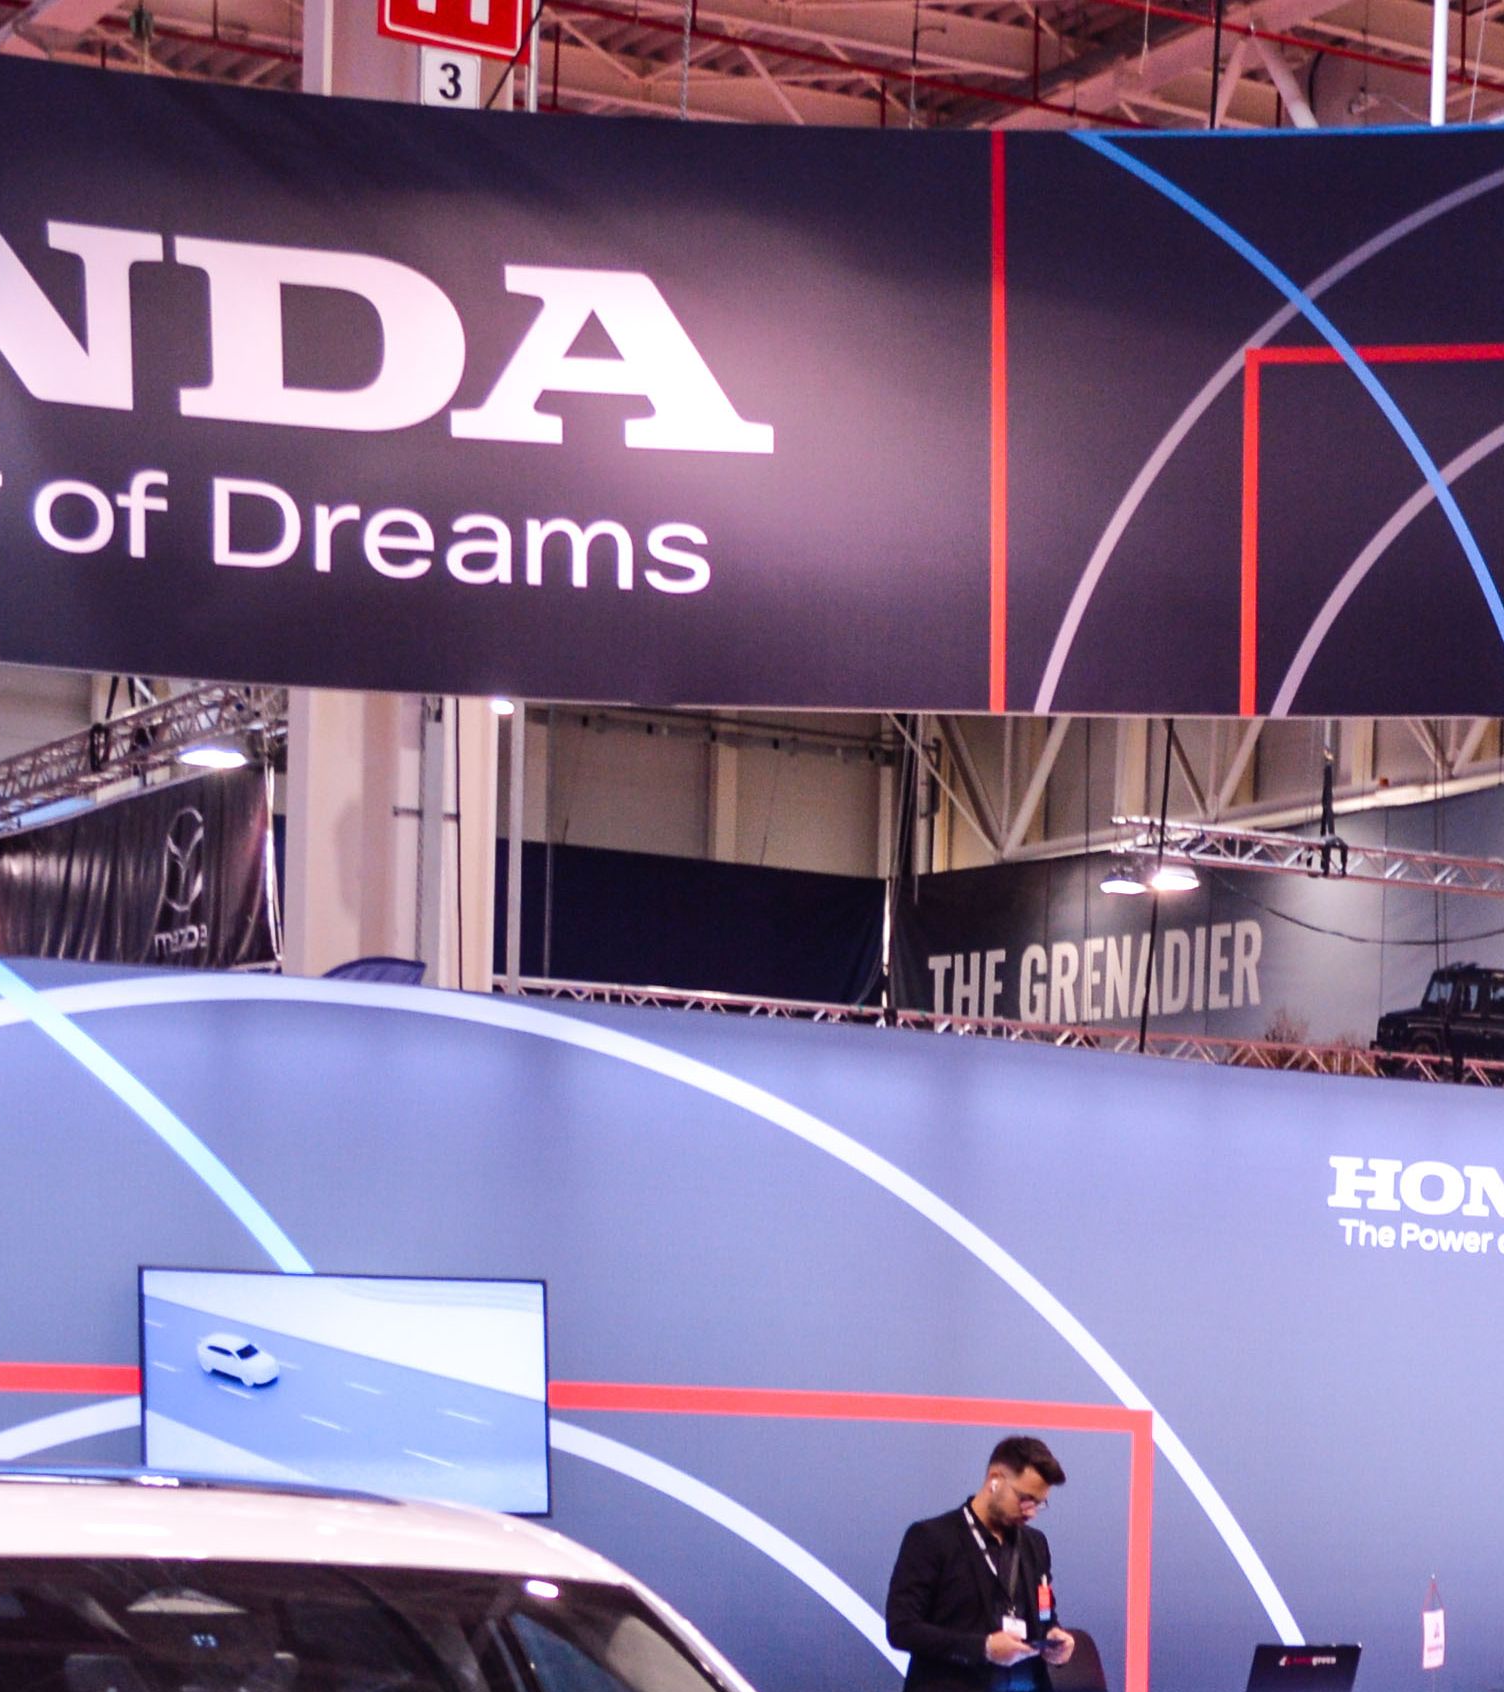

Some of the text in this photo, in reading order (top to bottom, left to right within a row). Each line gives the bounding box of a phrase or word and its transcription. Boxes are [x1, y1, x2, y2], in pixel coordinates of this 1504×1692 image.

[439, 62, 462, 101] 3
[33, 469, 168, 559] of
[213, 477, 711, 597] Dreams
[928, 919, 1263, 1037] THE GRENADIER
[1338, 1217, 1396, 1248] The
[1400, 1222, 1495, 1253] Power
